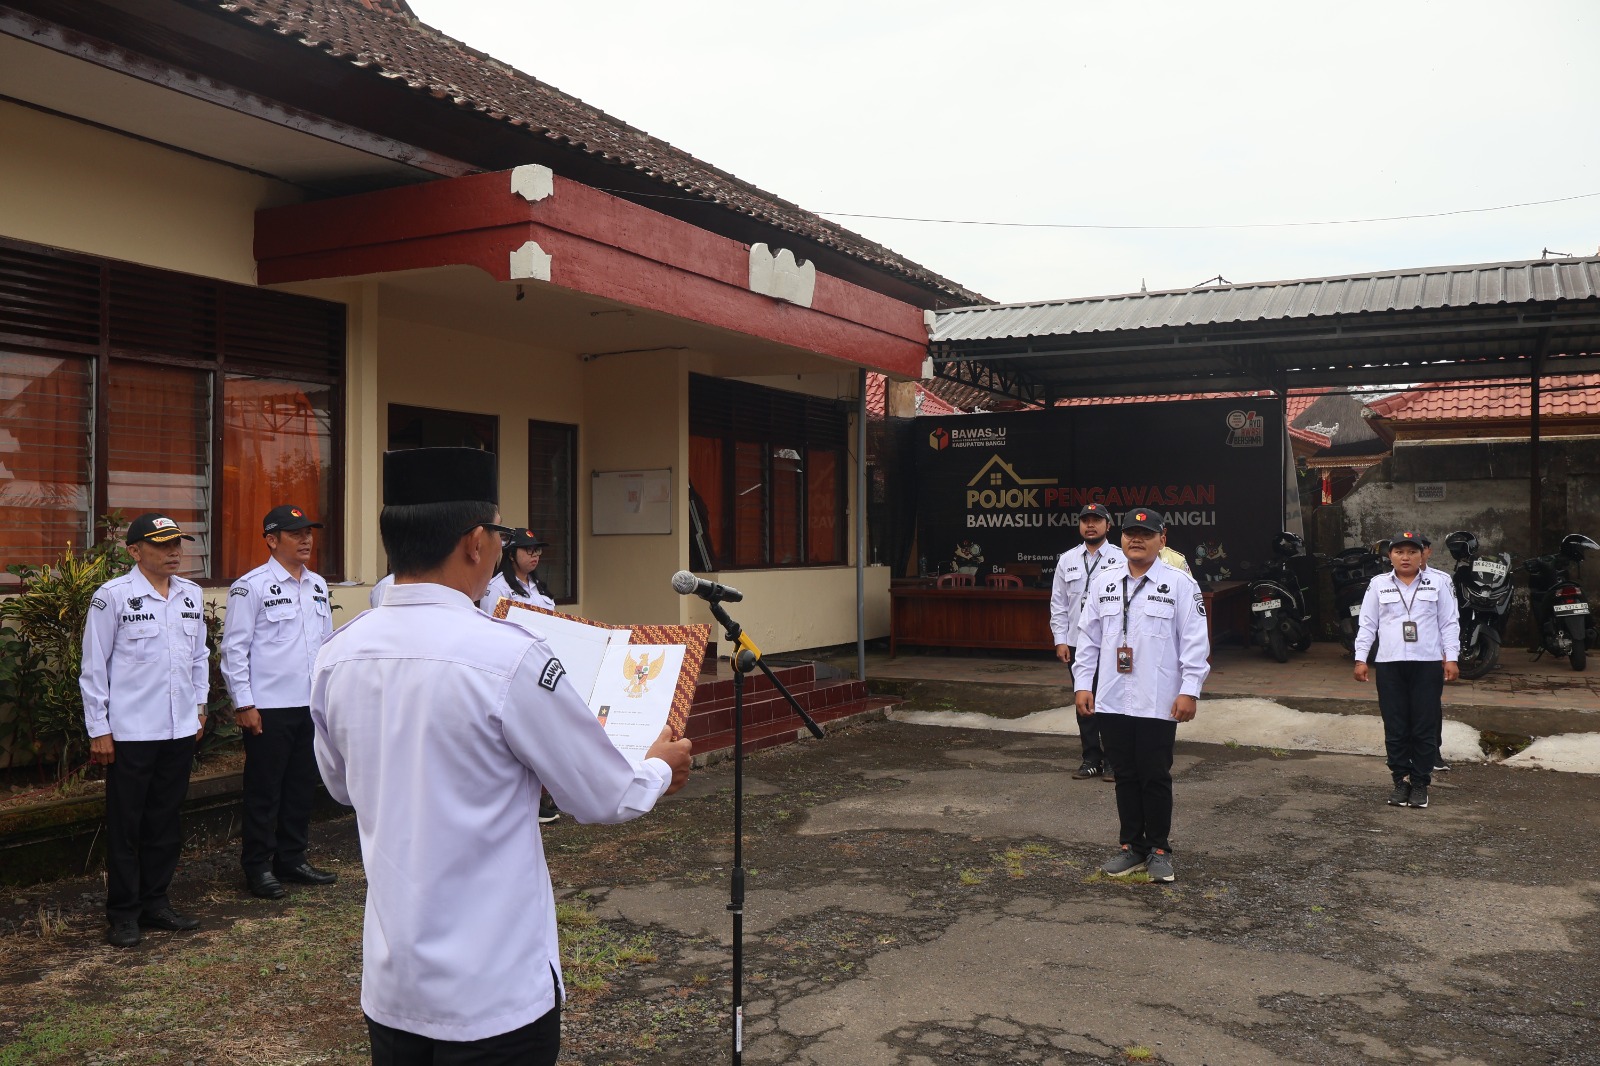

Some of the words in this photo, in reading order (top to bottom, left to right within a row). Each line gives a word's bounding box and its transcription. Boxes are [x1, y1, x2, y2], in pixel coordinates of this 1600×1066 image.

[1249, 419, 1261, 428] AYO
[966, 488, 1040, 509] POJOK
[1044, 484, 1215, 508] PENGAWASAN
[966, 513, 1043, 528] BAWASLU
[1162, 511, 1216, 526] ANGLI
[1017, 552, 1054, 561] Bersama
[122, 613, 156, 623] PURNA
